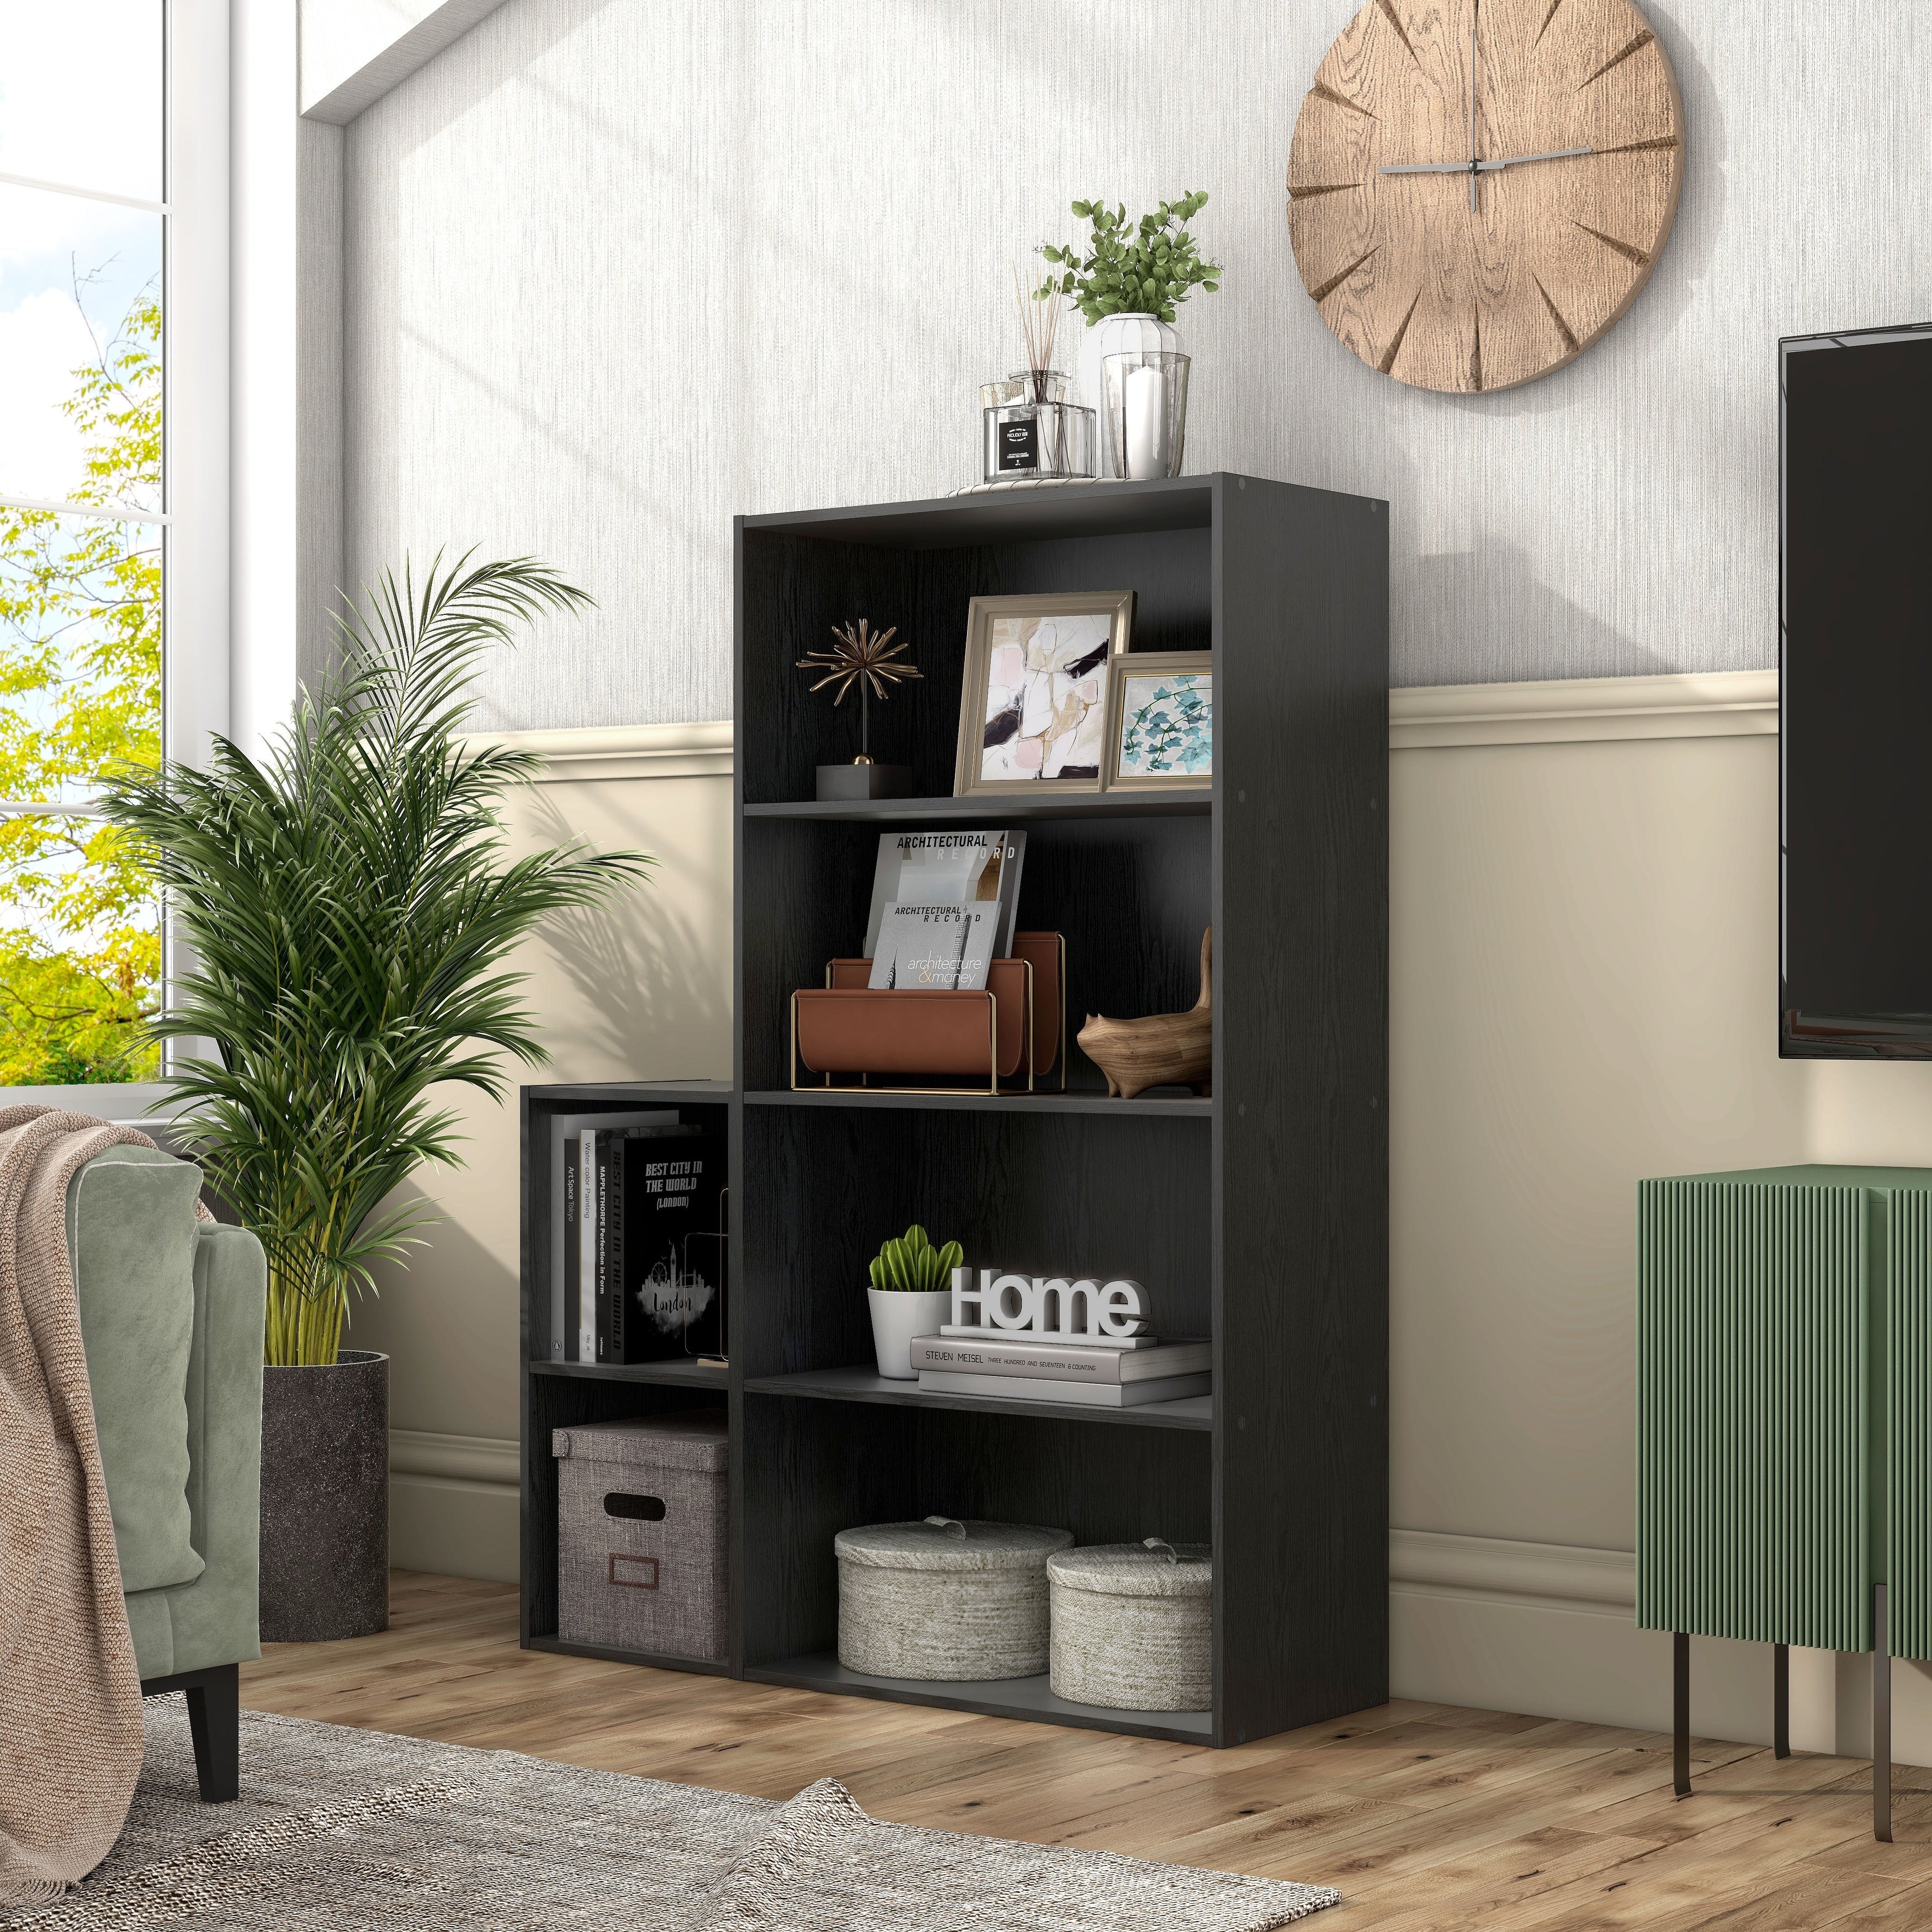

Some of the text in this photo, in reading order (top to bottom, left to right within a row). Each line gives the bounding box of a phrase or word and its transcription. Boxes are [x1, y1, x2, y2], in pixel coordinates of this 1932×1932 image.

[897, 835, 988, 848] ARCHITECTURAL
[937, 847, 1015, 860] RECORD
[895, 906, 961, 915] ARCHITECTURAL
[923, 914, 981, 922] RECORD
[907, 950, 981, 970] architecture
[645, 1161, 702, 1176] BEST CITY IN
[646, 1177, 697, 1193] THE WORLD
[657, 1196, 689, 1210] (LONDON)
[613, 1235, 621, 1253] IN
[654, 1292, 693, 1314] London
[951, 1266, 1151, 1337] Home
[926, 1351, 953, 1361] STEVEN
[958, 1353, 984, 1363] MEISEL
